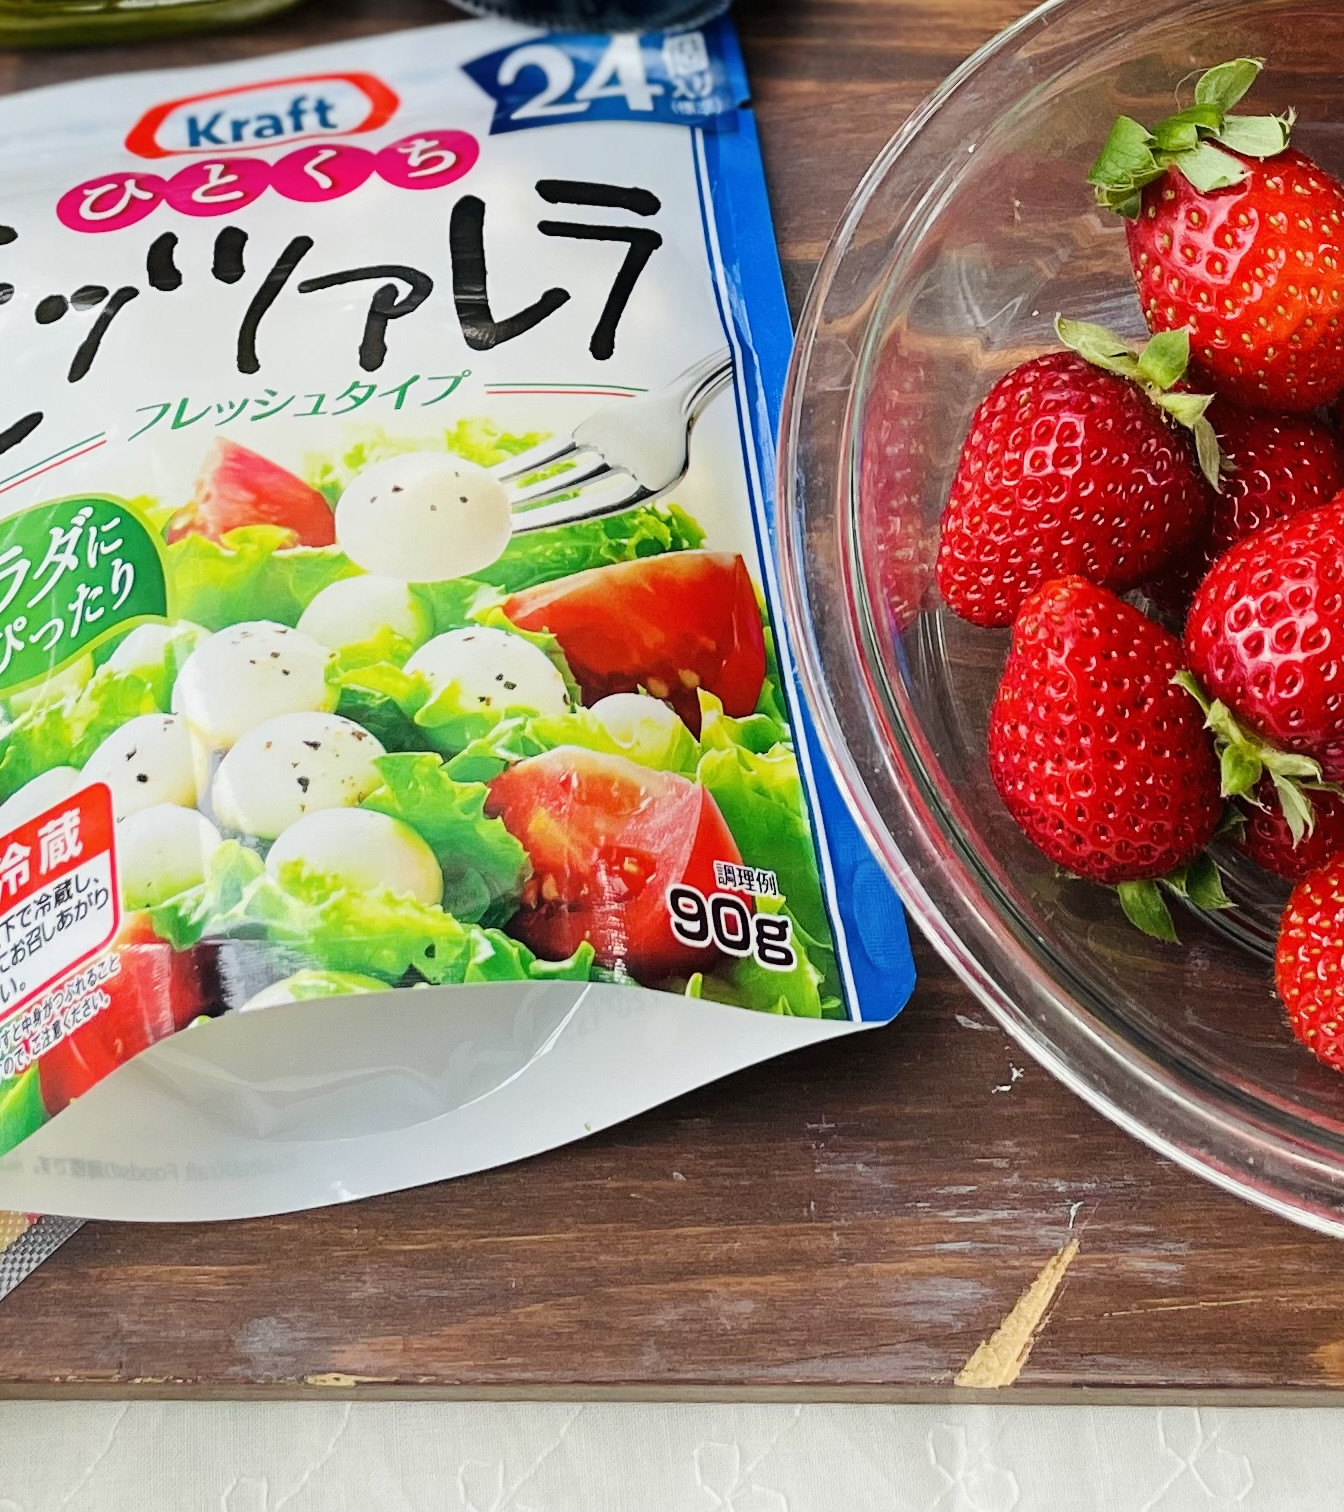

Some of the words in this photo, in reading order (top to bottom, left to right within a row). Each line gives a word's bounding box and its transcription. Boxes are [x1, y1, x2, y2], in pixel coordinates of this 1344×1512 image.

[497, 32, 665, 120] 24
[186, 91, 339, 150] Kraft
[80, 137, 459, 218] ひとくち
[127, 368, 473, 442] フレッシュタイプ
[716, 861, 778, 896] 調理例
[669, 885, 795, 970] 90g
